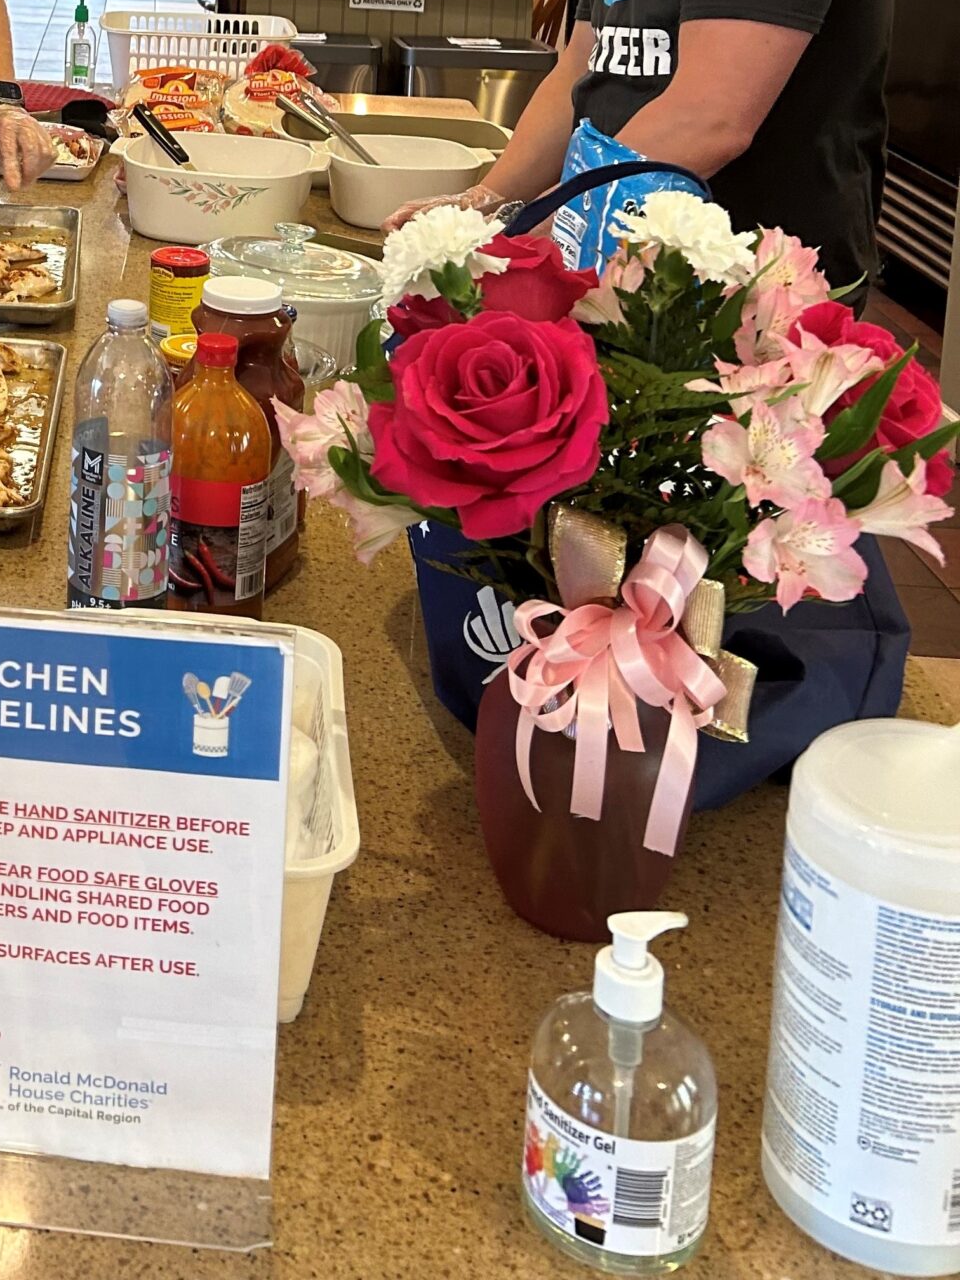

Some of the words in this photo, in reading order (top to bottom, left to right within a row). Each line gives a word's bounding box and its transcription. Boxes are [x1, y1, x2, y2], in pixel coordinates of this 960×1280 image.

[78, 485, 95, 590] ALKALINE
[14, 802, 68, 821] HAND
[73, 807, 172, 830] SANITIZER
[176, 816, 251, 836] BEFORE
[18, 824, 58, 840] AND
[62, 828, 167, 850] APPLIANCE
[172, 837, 213, 854] USE.
[37, 866, 88, 884] FOOD
[93, 871, 140, 889] SAFE
[144, 876, 219, 896] GLOVES
[76, 890, 153, 910] SHARED
[158, 898, 210, 916] FOOD
[32, 907, 72, 924] AND
[77, 911, 128, 928] FOOD
[134, 916, 194, 935] ITEMS.
[95, 953, 154, 972] AFTER
[159, 959, 200, 977] USE.
[9, 1066, 71, 1085] Ronald
[76, 1073, 168, 1095] McDonald
[8, 1083, 65, 1101] House
[70, 1089, 150, 1109] Charities
[7, 1102, 21, 1111] of
[24, 1103, 44, 1114] the
[47, 1105, 93, 1120] Capital
[96, 1110, 141, 1125] Region
[543, 1101, 591, 1145] Sanitizer
[593, 1136, 616, 1155] Gel
